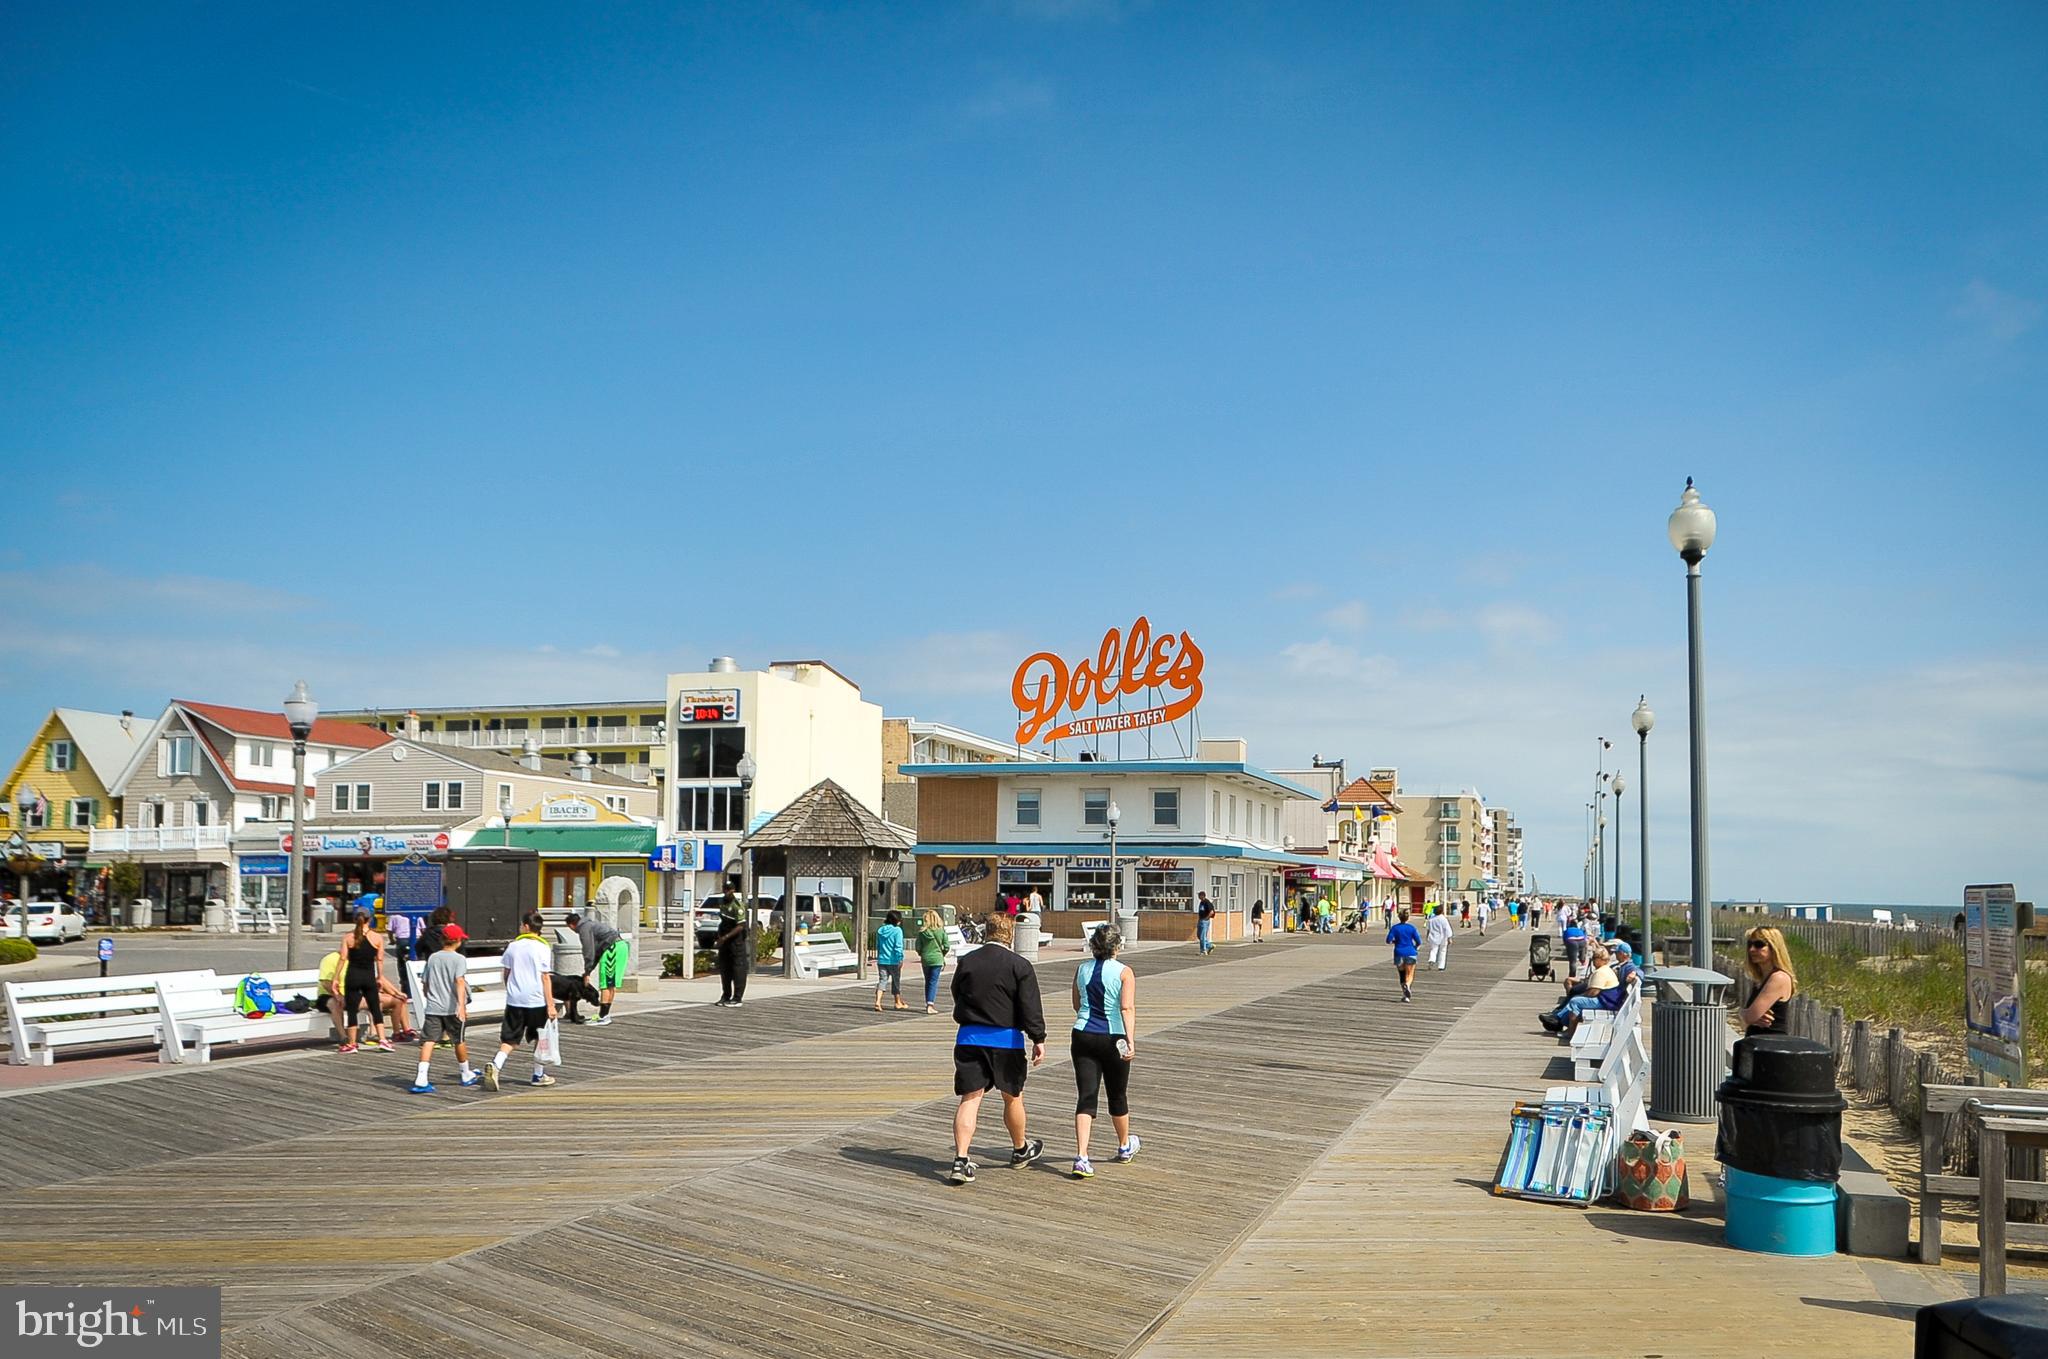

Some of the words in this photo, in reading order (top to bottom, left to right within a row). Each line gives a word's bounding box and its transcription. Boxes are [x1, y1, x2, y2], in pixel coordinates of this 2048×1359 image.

[1068, 720, 1093, 736] SALT
[1094, 715, 1132, 733] WATER
[1133, 709, 1168, 728] TAFFY
[549, 806, 588, 814] IBACH'S
[1000, 856, 1041, 868] Fudge
[1076, 857, 1110, 867] CORN
[1143, 856, 1179, 870] Taffy
